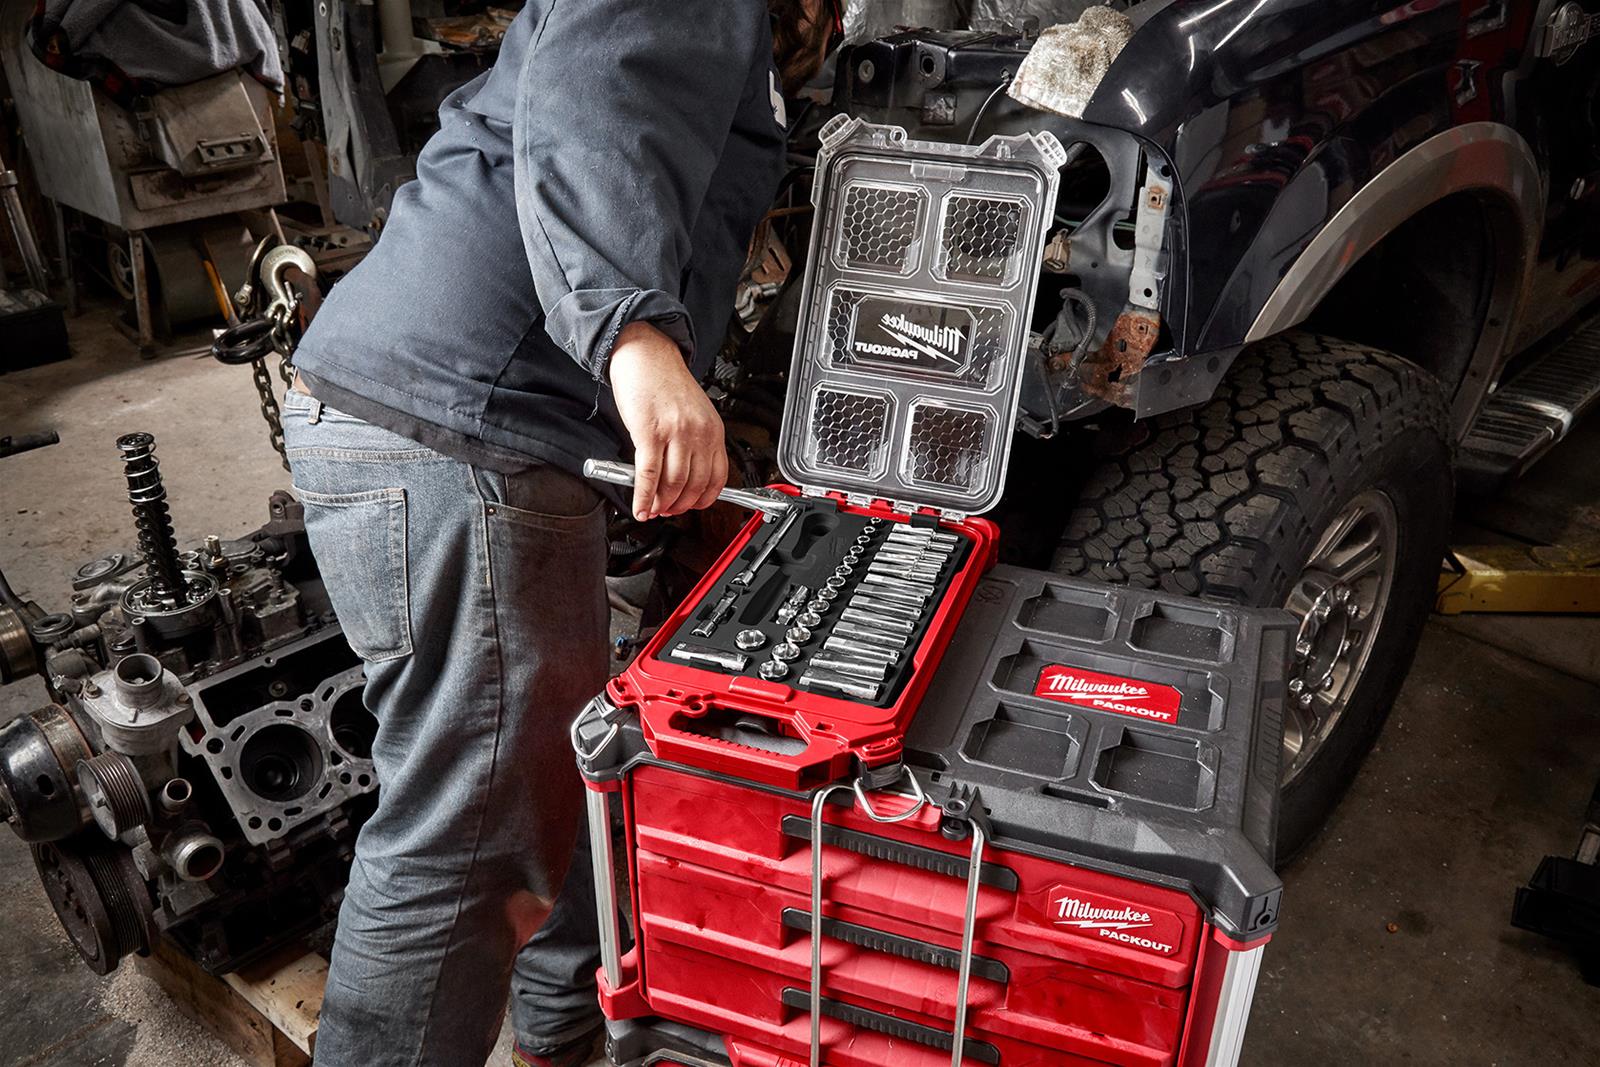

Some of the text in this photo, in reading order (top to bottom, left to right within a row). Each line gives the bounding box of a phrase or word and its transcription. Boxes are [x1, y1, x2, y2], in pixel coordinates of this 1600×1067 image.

[1046, 673, 1148, 695] Milwaukee
[1093, 699, 1171, 720] PACKOUT
[1054, 896, 1151, 922] Milwaukee
[1100, 929, 1172, 953] PACKOUT
